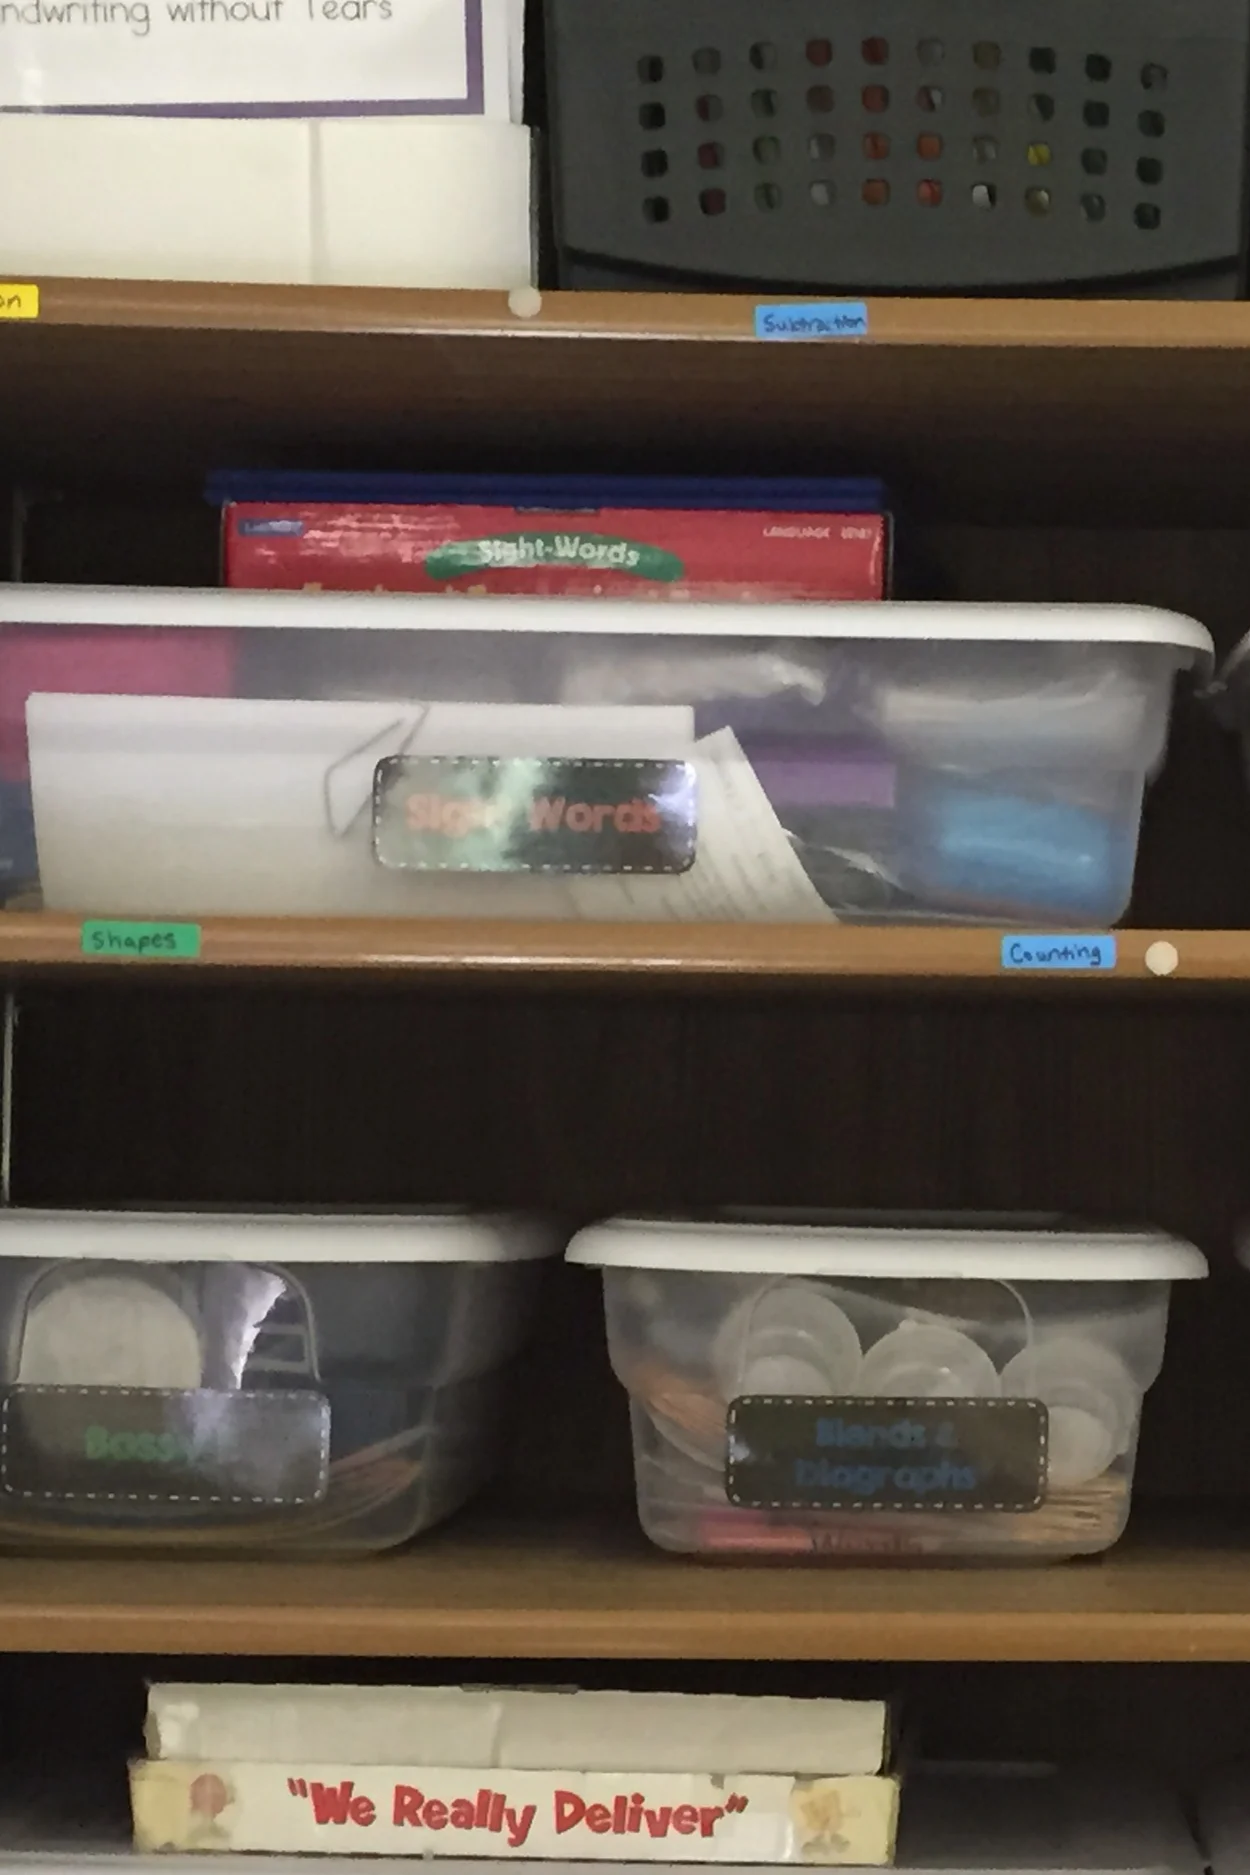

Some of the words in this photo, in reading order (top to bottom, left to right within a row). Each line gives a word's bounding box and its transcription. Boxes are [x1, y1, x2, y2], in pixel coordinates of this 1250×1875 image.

[168, 0, 284, 23] without
[526, 795, 661, 834] Words
[91, 929, 177, 953] Shapes
[1010, 942, 1102, 967] Counting
[393, 1784, 537, 1848] Really
